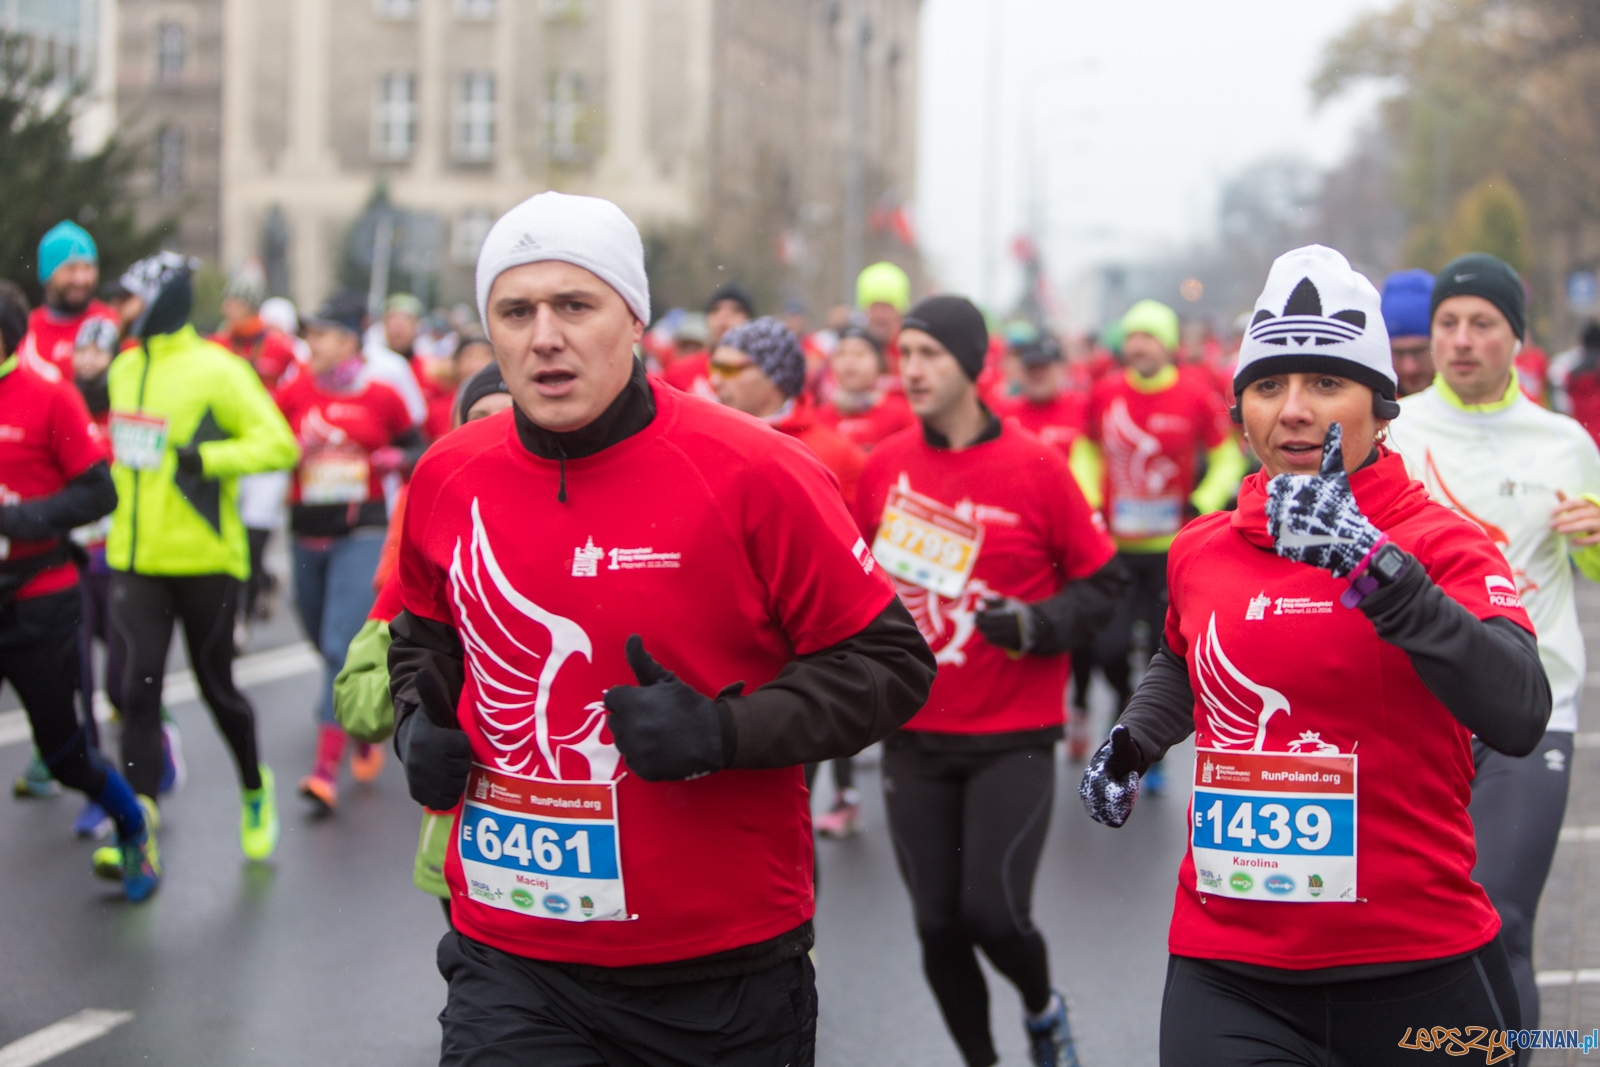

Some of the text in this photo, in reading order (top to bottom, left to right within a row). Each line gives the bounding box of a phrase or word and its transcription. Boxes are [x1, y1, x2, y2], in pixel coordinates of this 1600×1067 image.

[1261, 770, 1341, 785] RunPoland.org
[530, 795, 602, 811] RunPoland.org
[1195, 799, 1333, 851] E 1439
[463, 816, 592, 874] E 6461
[1233, 856, 1279, 869] Karolina
[516, 874, 550, 890] Maciej
